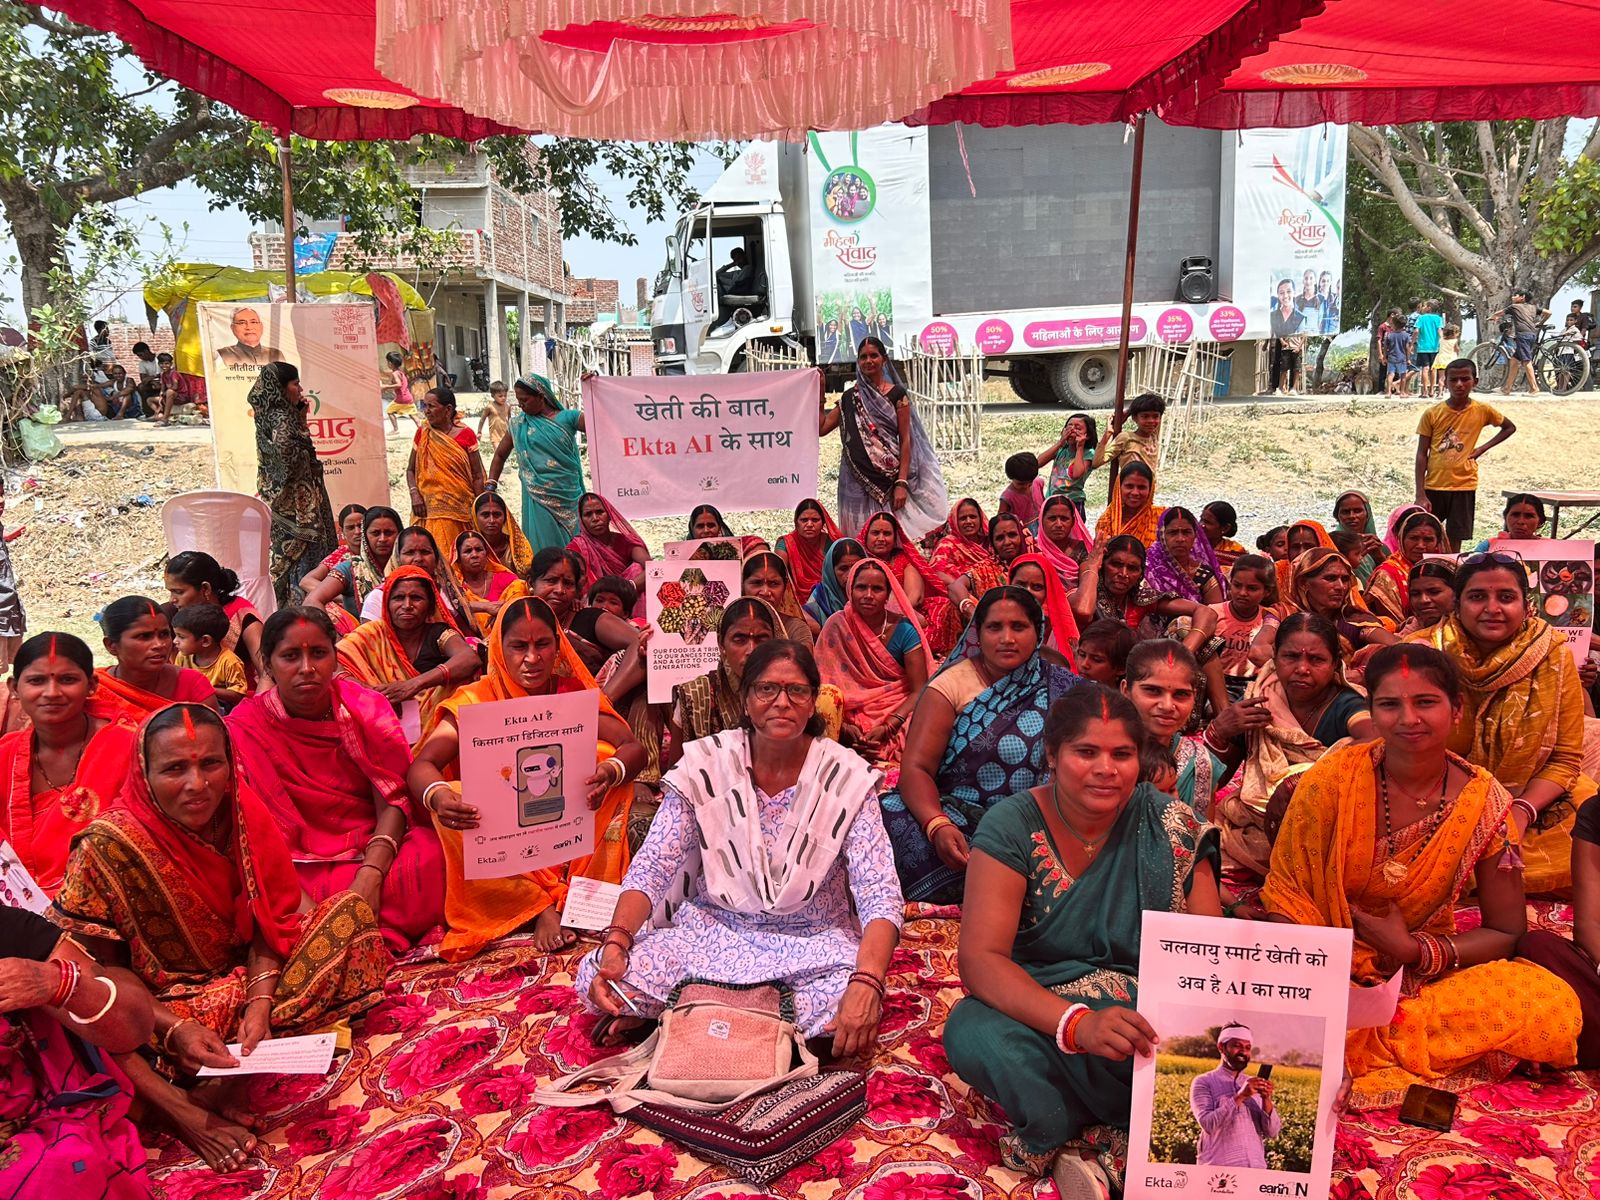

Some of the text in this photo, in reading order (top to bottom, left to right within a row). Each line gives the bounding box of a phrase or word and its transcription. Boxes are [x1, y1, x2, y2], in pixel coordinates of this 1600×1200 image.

[836, 245, 876, 266] संवाद
[1031, 324, 1139, 341] महिलाओं के लिए आरण
[228, 362, 256, 372] नीतीश
[634, 394, 775, 421] खेती की बात,
[306, 417, 356, 440] वाद
[623, 427, 793, 457] Ekta AI के साथ
[504, 710, 553, 726] Ekta AI है
[472, 724, 584, 748] किसान का डिजिटल साथी
[1160, 940, 1328, 967] जलवायु स्मार्ट खेती को
[1178, 974, 1312, 1000] अब है AI का साथ
[1145, 1176, 1173, 1188] Ekta
